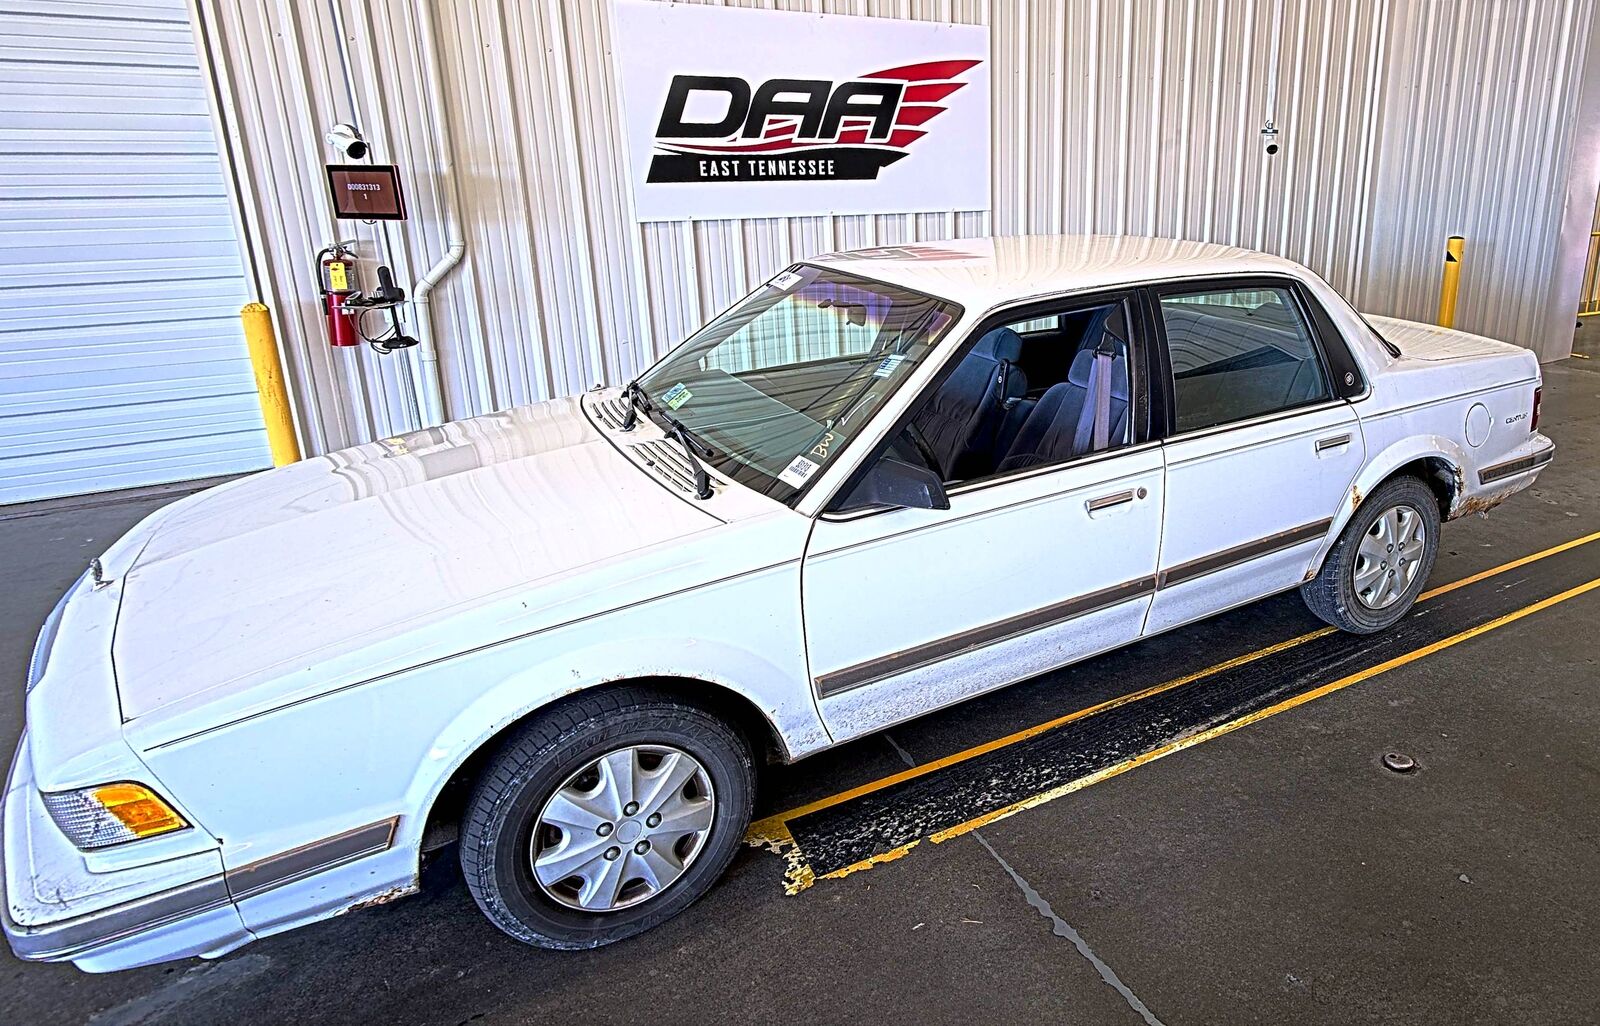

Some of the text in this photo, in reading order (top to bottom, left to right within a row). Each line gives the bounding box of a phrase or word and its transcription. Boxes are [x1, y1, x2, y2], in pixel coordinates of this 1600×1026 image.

[655, 75, 904, 138] DAA
[700, 160, 835, 176] EAST TENNESSEE
